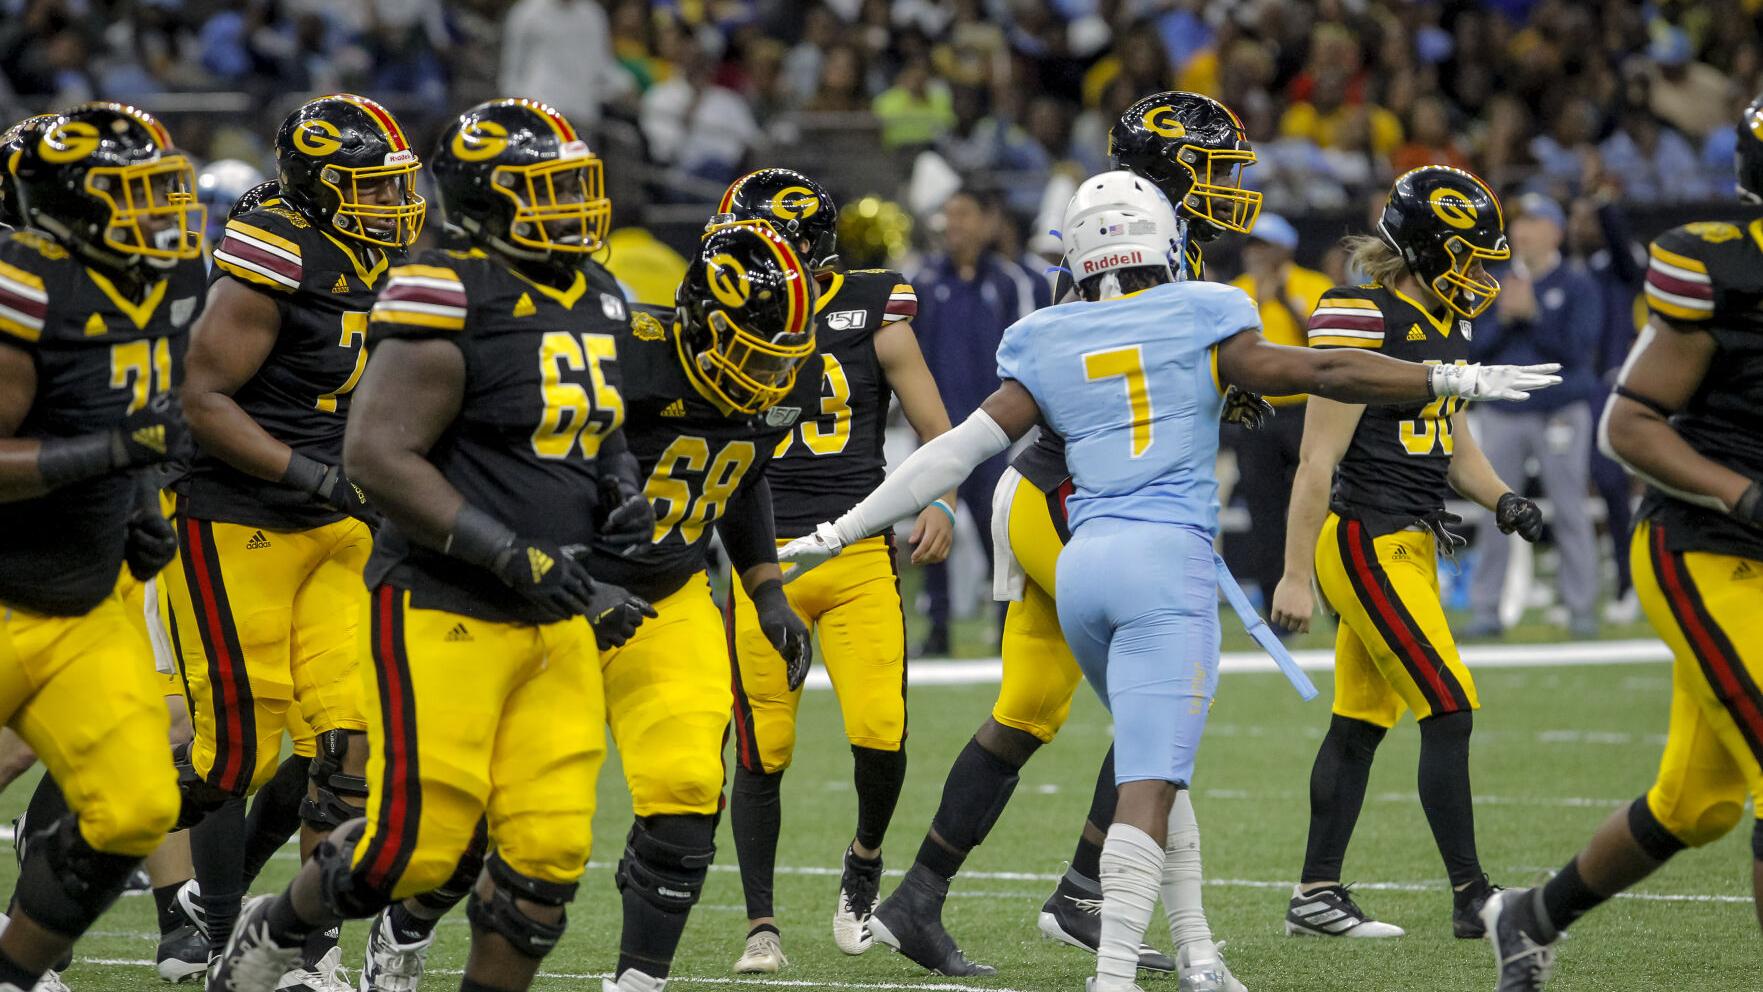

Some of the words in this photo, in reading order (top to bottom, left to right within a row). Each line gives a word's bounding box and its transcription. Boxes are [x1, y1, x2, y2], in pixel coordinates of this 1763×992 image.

[292, 119, 342, 157] G
[451, 122, 508, 162] G
[1141, 106, 1186, 138] G
[39, 122, 99, 164] G
[770, 186, 819, 220] G
[1428, 188, 1477, 229] G
[705, 252, 750, 308] G
[1083, 251, 1141, 274] Riddell
[825, 309, 868, 331] 150
[109, 337, 172, 417] 71
[530, 331, 626, 460] 65
[772, 352, 852, 462] 3
[1081, 344, 1156, 460] 7
[642, 435, 756, 545] 68
[246, 540, 272, 550] adidas
